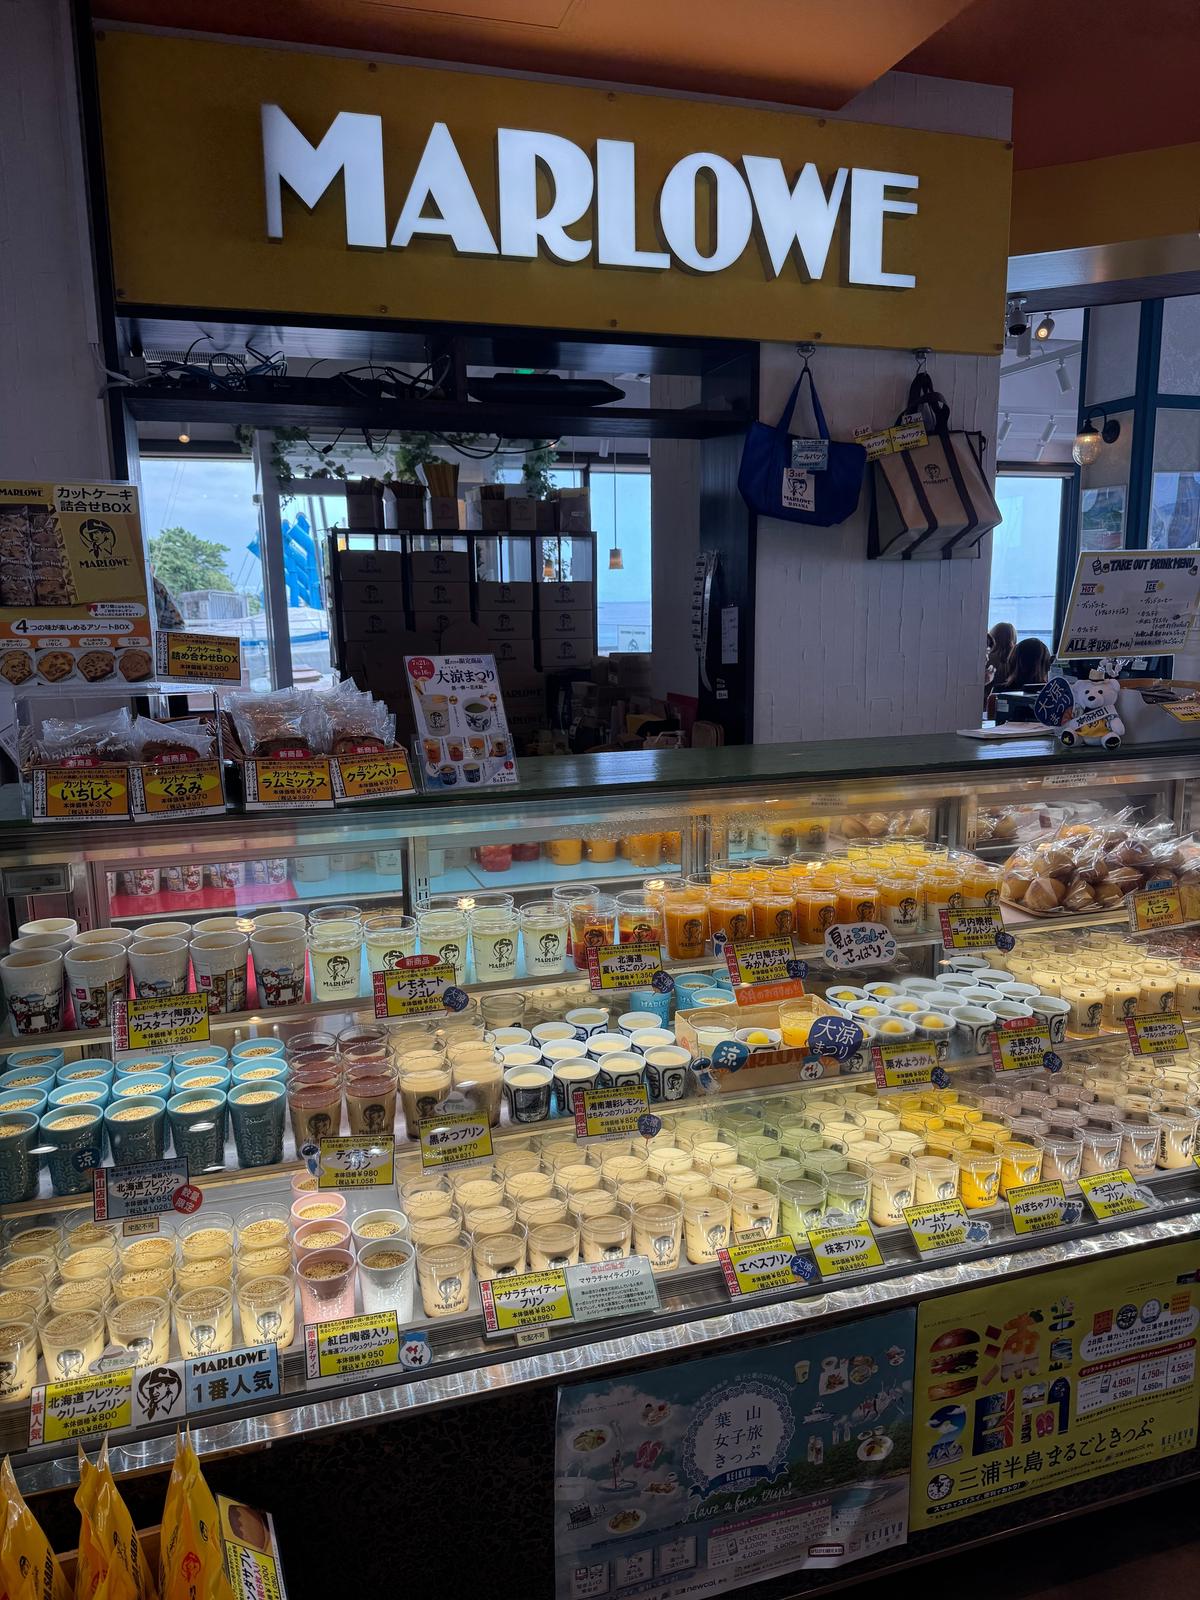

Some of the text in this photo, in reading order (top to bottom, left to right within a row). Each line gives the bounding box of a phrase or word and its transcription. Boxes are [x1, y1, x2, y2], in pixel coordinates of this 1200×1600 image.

[261, 103, 920, 289] MARLOWE
[58, 487, 133, 501] カットケーキ
[784, 495, 813, 504] MARLOWE
[61, 501, 131, 513] 詰合せBOX
[80, 559, 129, 569] MARLOWE
[1109, 557, 1195, 572] TAKE OUT DRINK MENU
[1082, 585, 1096, 593] HOT
[1145, 583, 1157, 591] ICE
[16, 619, 130, 634] 4つの味が楽しめるアソートBOX
[187, 645, 223, 653] カットケーキ
[1066, 638, 1086, 652] ALL
[172, 652, 238, 664] 詰め合わせBOX
[435, 668, 495, 684] 大涼まつり
[279, 750, 304, 758] 新商品
[357, 762, 392, 771] カットケーキ
[159, 773, 205, 784] カットケーキ
[272, 770, 315, 778] カットケーキ
[347, 768, 407, 783] クランベリー
[64, 780, 111, 789] カットケーキ
[164, 782, 202, 796] くるみ
[262, 777, 327, 789] ラムミックス
[61, 787, 113, 801] いちじく
[1146, 903, 1170, 916] バニラ
[958, 917, 993, 927] 河内晩柑
[952, 927, 1003, 937] ヨーグルトジュレ
[534, 955, 562, 964] MARLOWE
[617, 954, 643, 964] 北海道
[842, 944, 882, 964] さっぱり
[405, 957, 430, 967] 新商品
[602, 962, 660, 975] 夏いちごのジュレ
[745, 957, 789, 970] みかんジュレ
[751, 966, 786, 975] 本体価格¥930
[323, 978, 355, 988] MARLOWE
[397, 976, 444, 991] レモネード
[408, 988, 435, 1000] ジュレ
[401, 996, 443, 1007] 本体価格¥800
[130, 1006, 207, 1022] ハローキティ陶器入り
[134, 1017, 204, 1033] カスタードプリン
[142, 1027, 197, 1040] 本体価格¥1,200
[813, 1019, 858, 1046] 大涼
[1009, 1037, 1041, 1048] 玉露茶の
[718, 1046, 741, 1067] 涼
[812, 1042, 849, 1060] まつり
[1009, 1046, 1045, 1056] 水ようかん
[885, 1054, 936, 1071] 栗水ようかん
[589, 1098, 644, 1111] 湘南潮彩レモンと
[587, 1106, 648, 1119] はちみつのブリュレプリン
[429, 1126, 485, 1146] 黒みつプリン
[78, 1151, 96, 1168] 涼
[343, 1160, 372, 1171] プリン
[334, 1169, 379, 1178] 本体価格¥980
[116, 1178, 180, 1193] 北海道フレッシュ
[1092, 1180, 1128, 1195] チョコレート
[95, 1169, 110, 1219] 葉山店限定
[122, 1187, 175, 1200] クリームプリン
[1106, 1191, 1126, 1203] プリン
[911, 1210, 964, 1228] クリームチーズ
[927, 1228, 963, 1242] 本体価格¥830
[930, 1222, 953, 1234] プリン
[824, 1239, 867, 1256] 抹茶プリン
[738, 1253, 793, 1274] エペスプリン
[831, 1253, 869, 1267] 本体価格¥800
[578, 1269, 641, 1285] マサラチャイティプリン
[751, 1269, 790, 1283] 本体価格¥850
[495, 1284, 566, 1301] マサラチャイティー
[481, 1281, 497, 1330] 葉山店限定
[519, 1297, 545, 1309] プリン
[511, 1305, 556, 1320] 本体価格¥830
[327, 1326, 389, 1347] 紅白陶器入り
[521, 1332, 545, 1343] 宅配不可
[320, 1338, 398, 1357] 北海道フレッシュクリームプリン
[192, 1349, 270, 1376] MARLOWE
[307, 1331, 319, 1380] 限定デザイン
[335, 1350, 385, 1365] 本体価格¥950
[338, 1359, 384, 1373] (税込¥1,026)
[1141, 1368, 1165, 1381] 4,750円
[1172, 1374, 1191, 1385] 4,750円
[192, 1370, 274, 1404] 1番人気
[1112, 1376, 1136, 1390] 4,950円
[1143, 1382, 1163, 1393] 4,950円
[48, 1385, 132, 1410] 北海道フレッシュ
[30, 1391, 44, 1441] 1番人気
[57, 1399, 127, 1421] クリームプリン
[63, 1411, 118, 1429] 本体価格¥800
[715, 1405, 761, 1430] 葉山
[67, 1423, 112, 1437] (税込¥864)
[1161, 1427, 1194, 1446] KEIKYU
[713, 1425, 764, 1451] 女子旅
[714, 1444, 761, 1469] きっぷ
[958, 1417, 1155, 1493] 三浦半島まるごときっぷ
[726, 1468, 752, 1482] KEIKYU
[865, 1521, 903, 1543] KEIKYU
